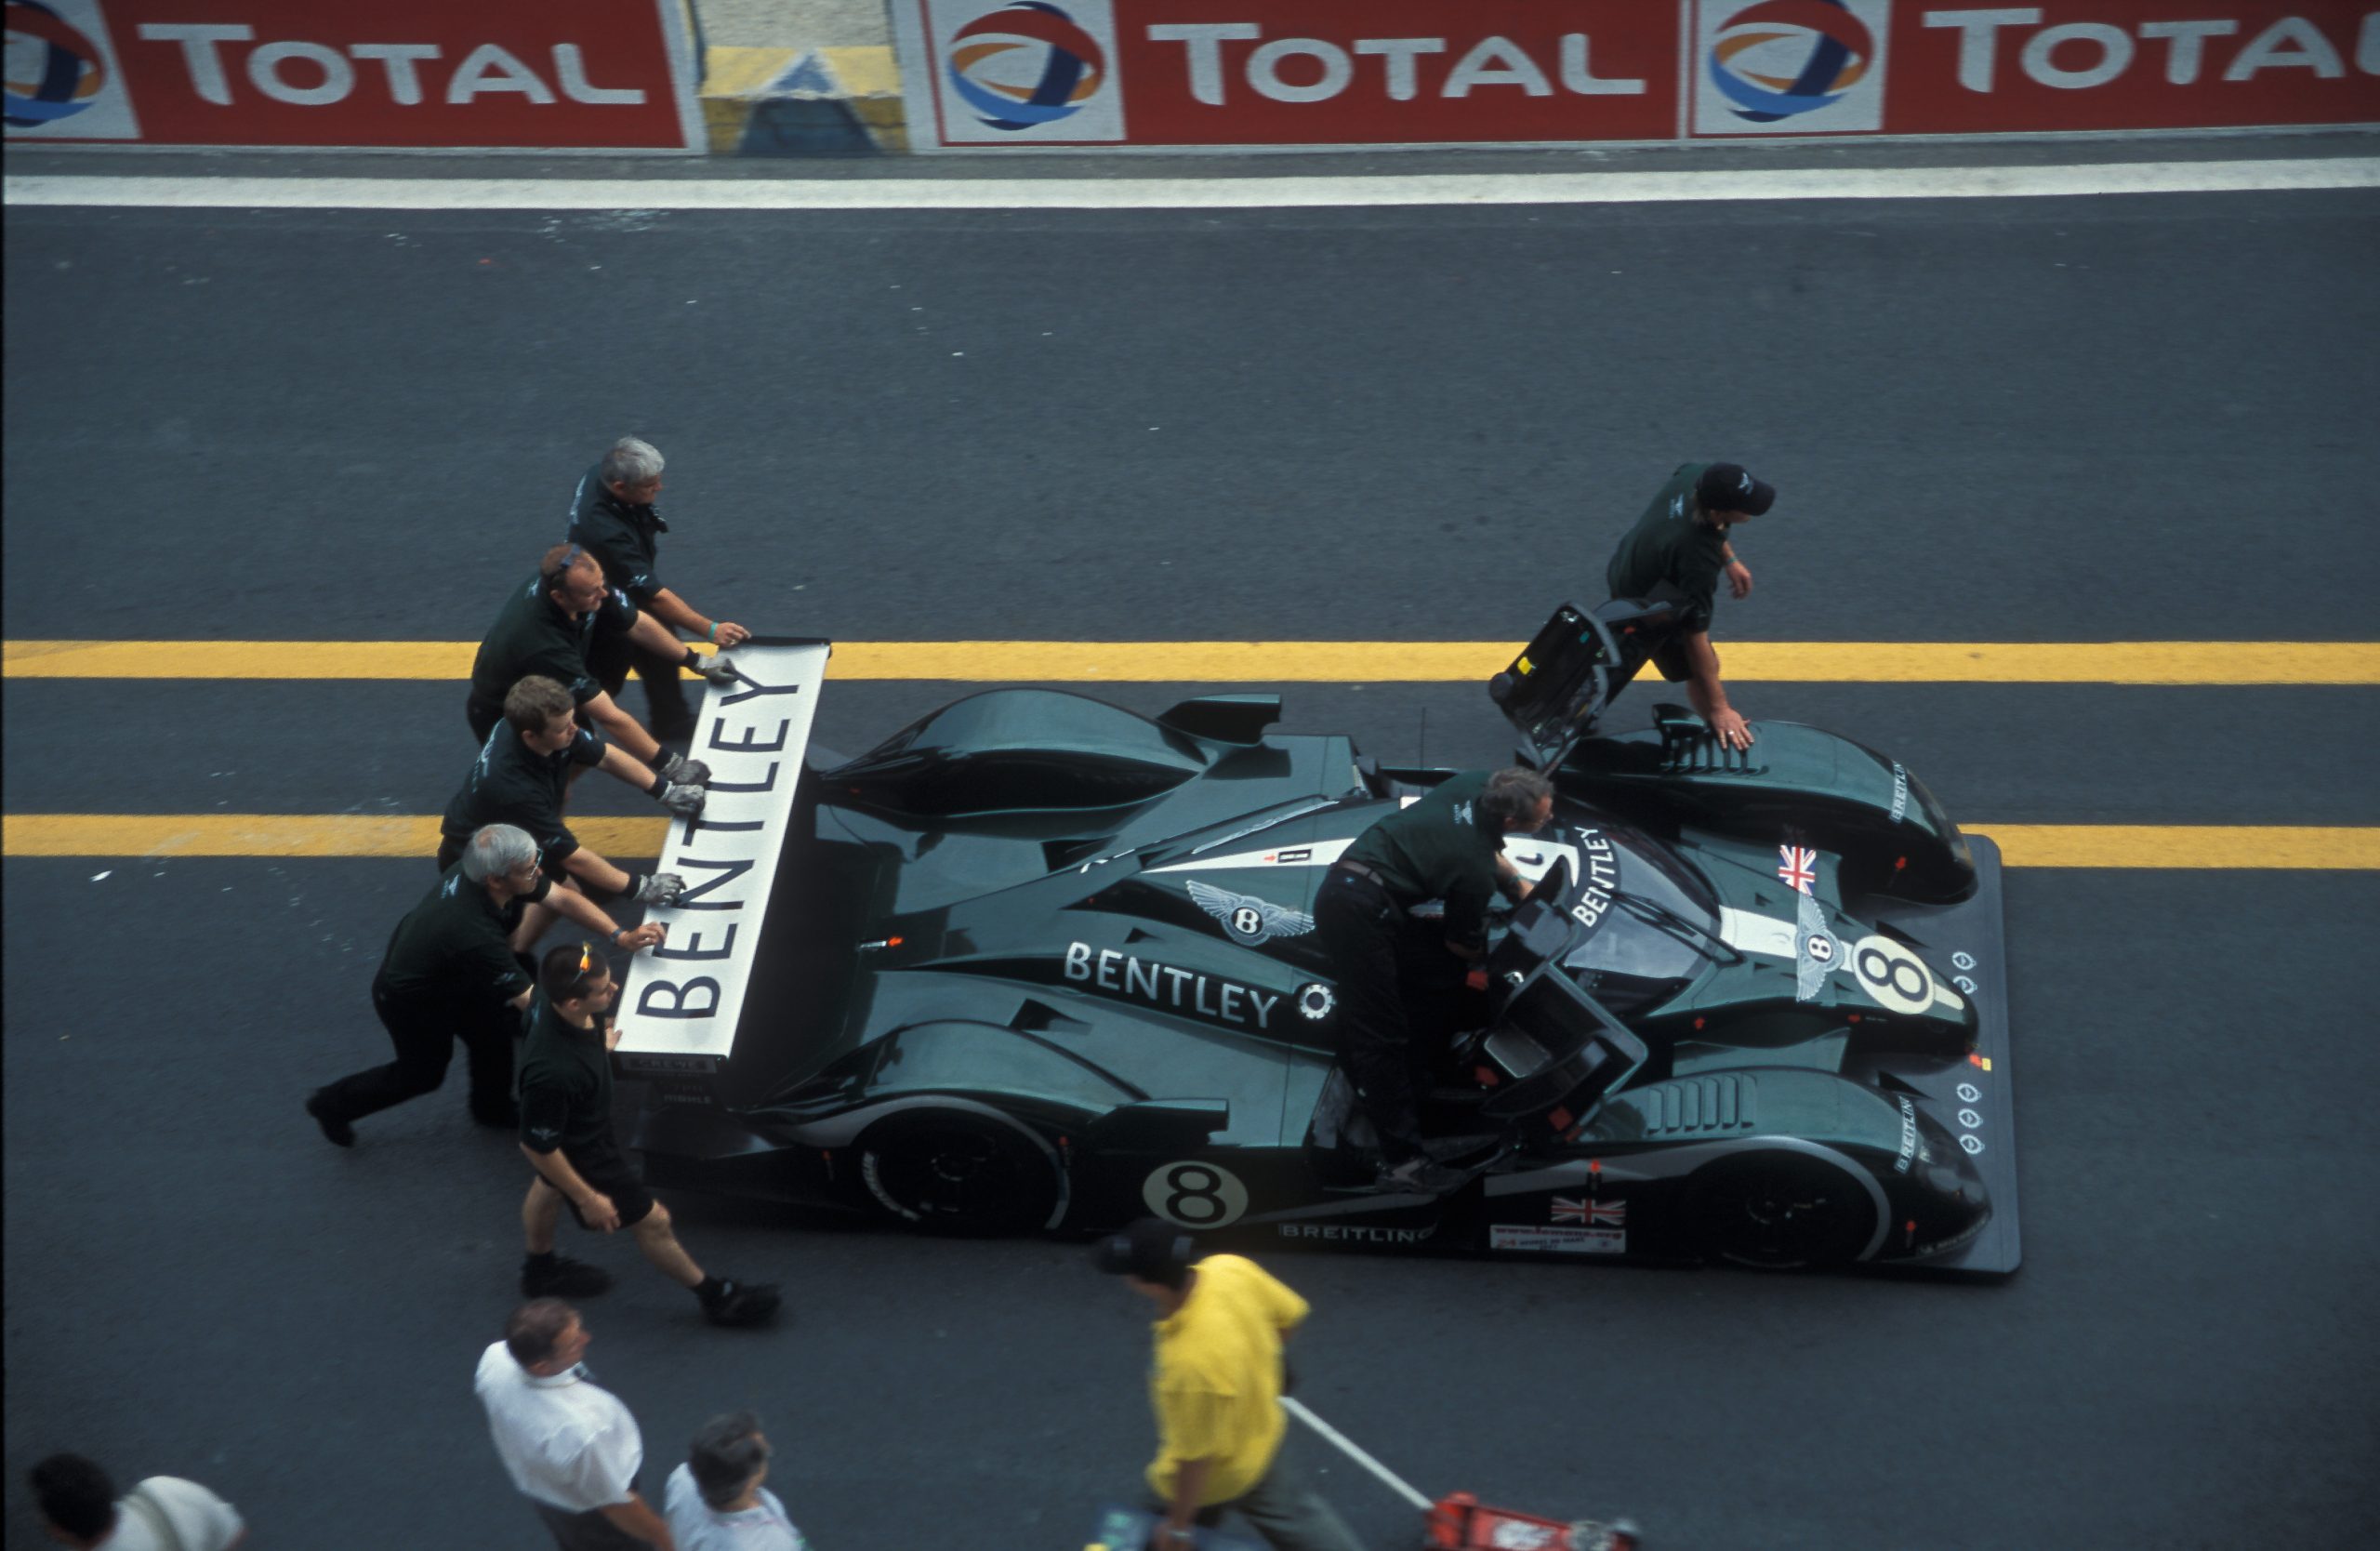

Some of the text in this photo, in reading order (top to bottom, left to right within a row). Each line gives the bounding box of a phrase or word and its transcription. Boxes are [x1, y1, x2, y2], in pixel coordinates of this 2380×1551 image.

[139, 23, 647, 106] TOTAL
[1145, 22, 1647, 106] TOTAL
[1890, 761, 1907, 820] BREITLIN
[636, 667, 799, 1020] BENTLEY
[1571, 826, 1616, 928] BENTLEY
[1064, 941, 1279, 1028] BENTLEY
[1858, 947, 1929, 1002] 8
[1166, 1164, 1227, 1225] 8
